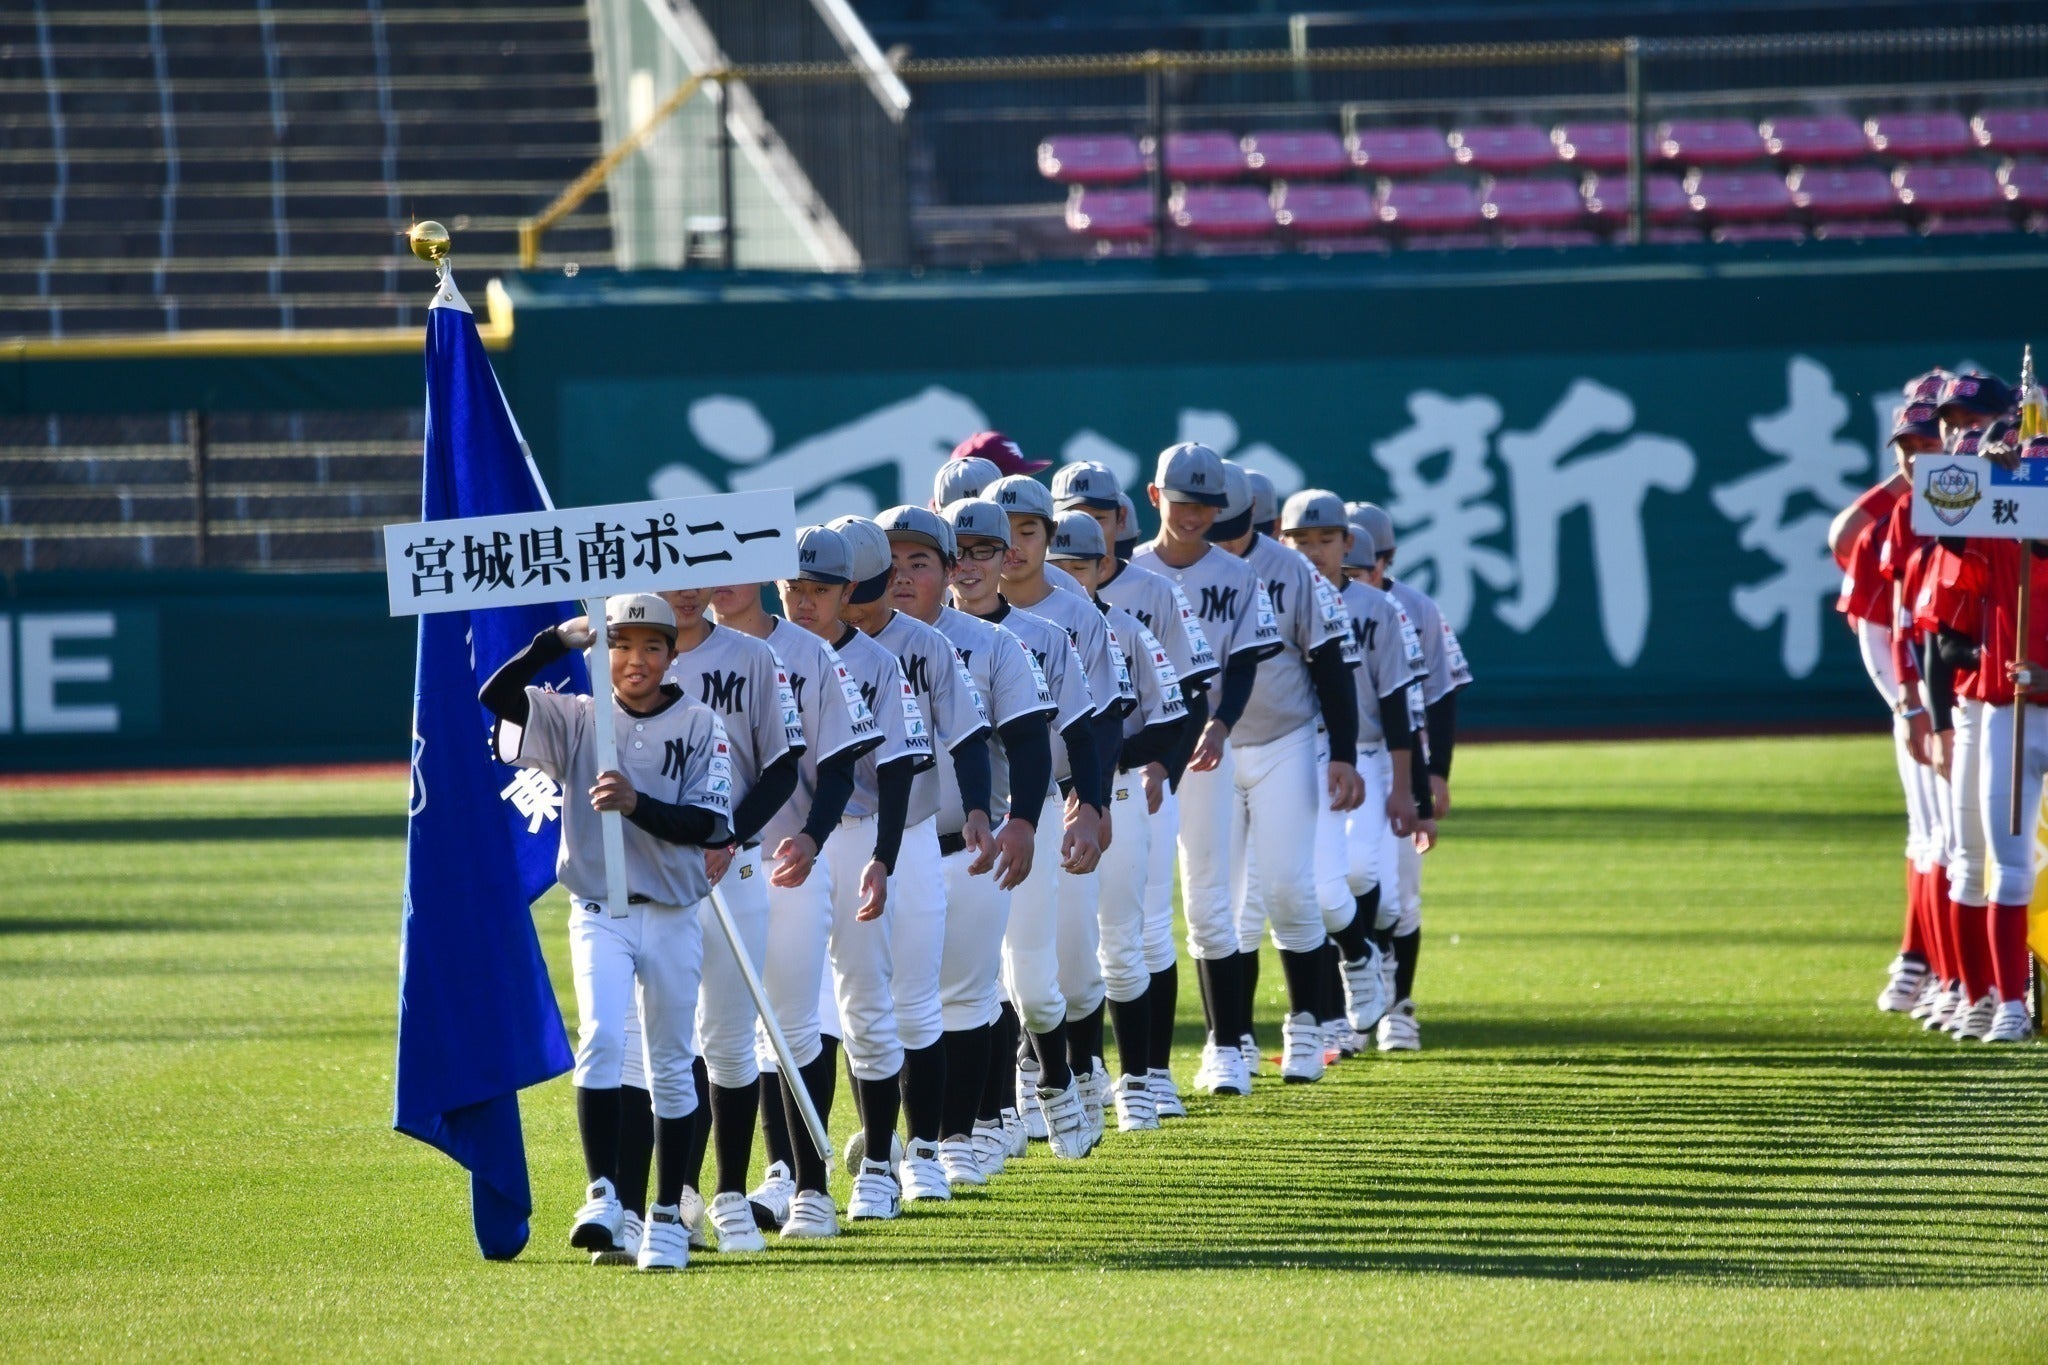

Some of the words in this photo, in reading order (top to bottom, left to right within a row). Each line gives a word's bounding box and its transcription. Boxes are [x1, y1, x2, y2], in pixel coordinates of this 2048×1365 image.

[404, 512, 782, 597] 宮城県南ポニー
[1992, 499, 2019, 525] 秋
[0, 612, 120, 734] E
